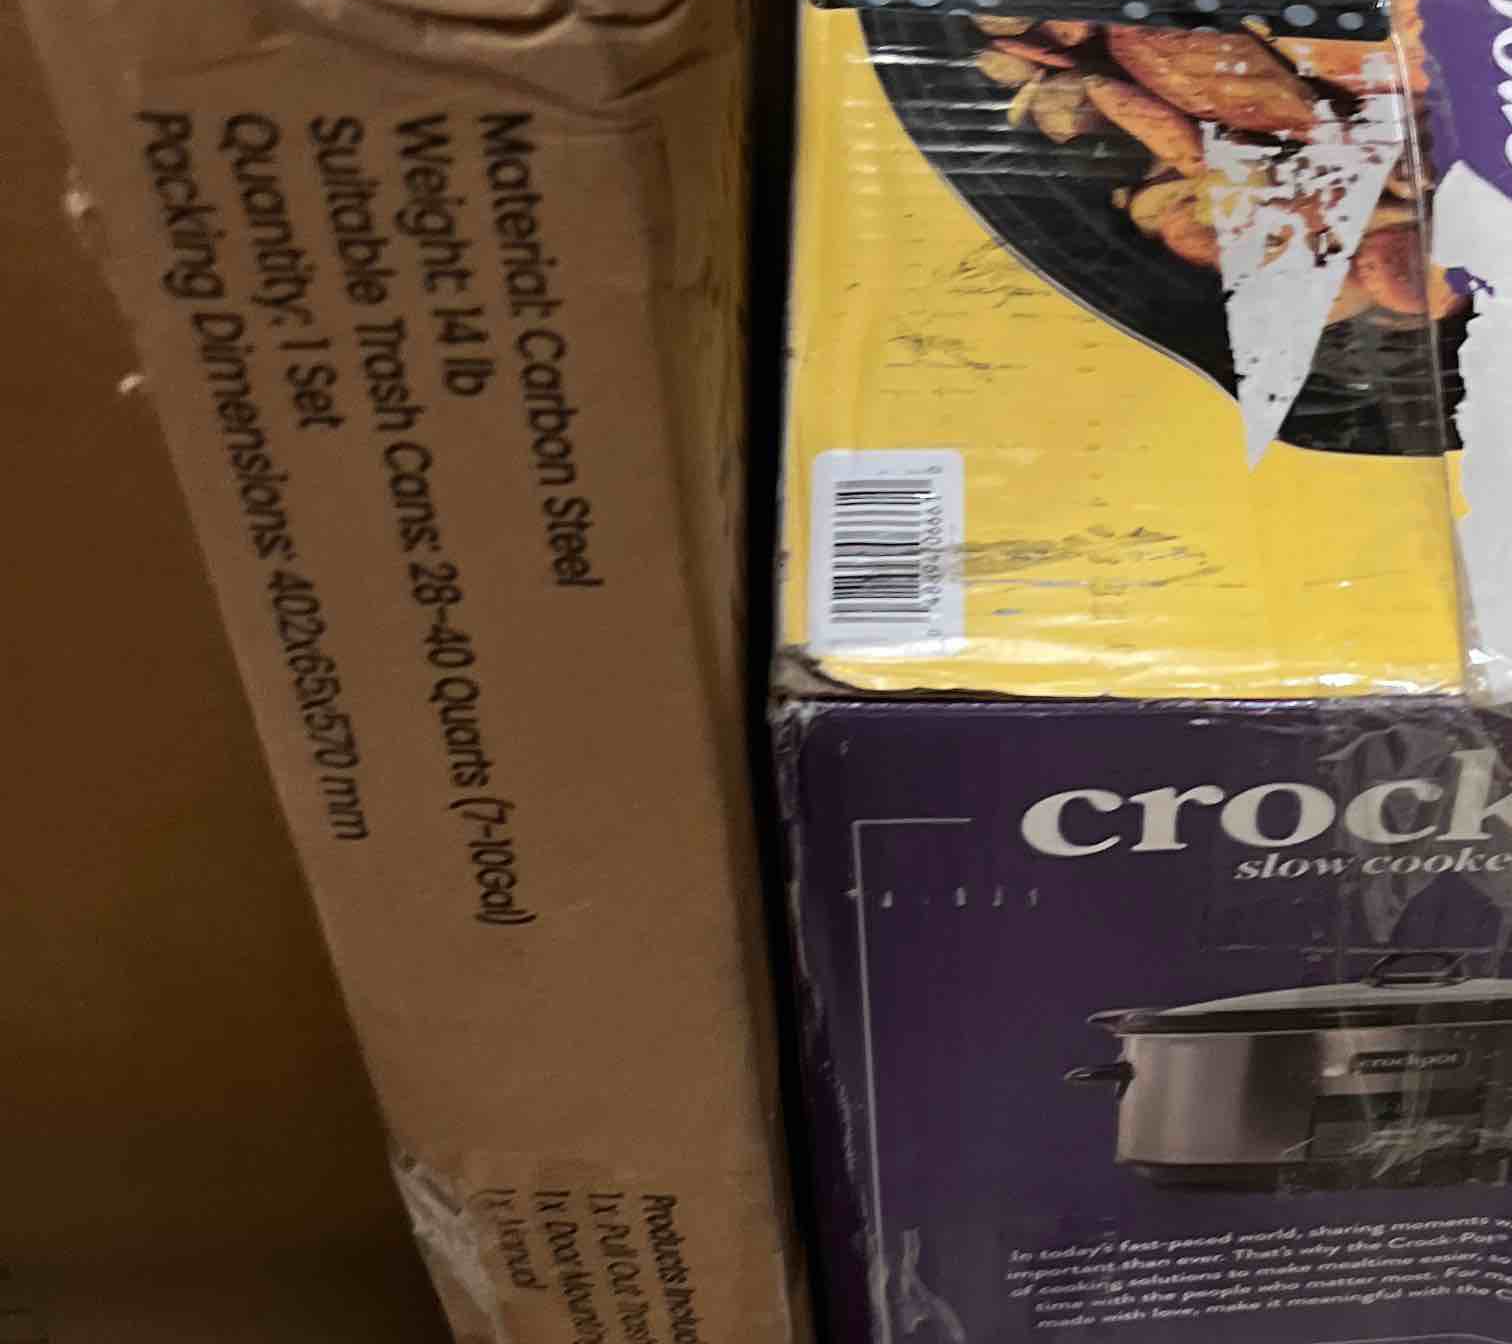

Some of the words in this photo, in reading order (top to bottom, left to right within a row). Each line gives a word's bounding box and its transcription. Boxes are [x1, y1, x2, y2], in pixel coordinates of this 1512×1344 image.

[309, 115, 397, 306] Suitable
[394, 113, 473, 293] Weight:
[478, 112, 564, 318] Material:
[218, 113, 318, 328] Quantity:
[285, 363, 346, 430] Set
[433, 305, 490, 344] 14
[354, 316, 424, 432] Trash
[444, 358, 495, 397] lb
[516, 330, 579, 486] Carbon
[133, 111, 229, 301] Packing
[191, 312, 296, 560] Dimensions:
[267, 569, 360, 771] 402x65x570
[319, 775, 369, 842] mm
[383, 442, 442, 553] Cans:
[544, 496, 605, 587] Steel
[409, 560, 476, 669] 28-40
[428, 677, 494, 789] Quarts
[1233, 852, 1354, 880] slow
